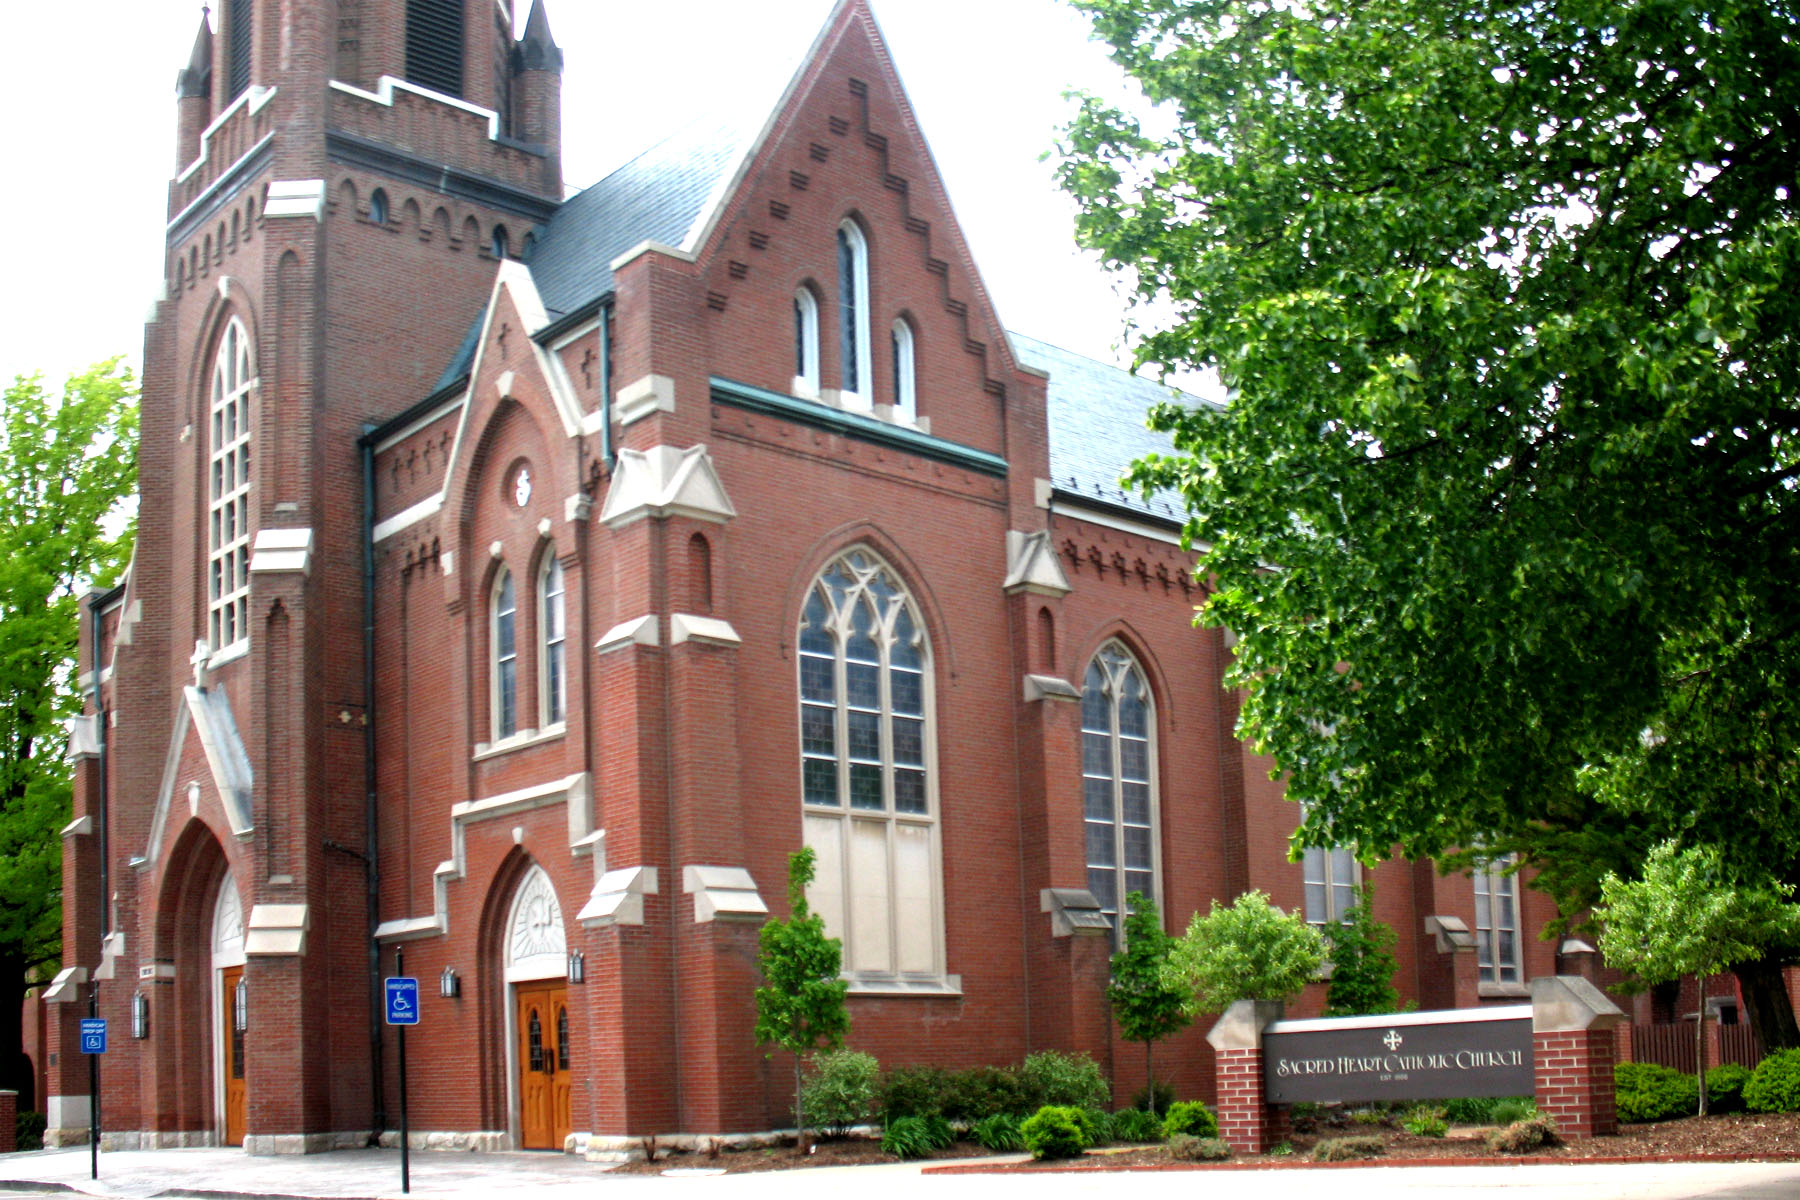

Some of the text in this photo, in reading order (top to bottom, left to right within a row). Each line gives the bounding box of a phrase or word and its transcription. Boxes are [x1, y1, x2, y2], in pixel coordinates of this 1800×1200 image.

[1277, 1050, 1522, 1077] SACRED HEART CATHOLIC CHURCH
